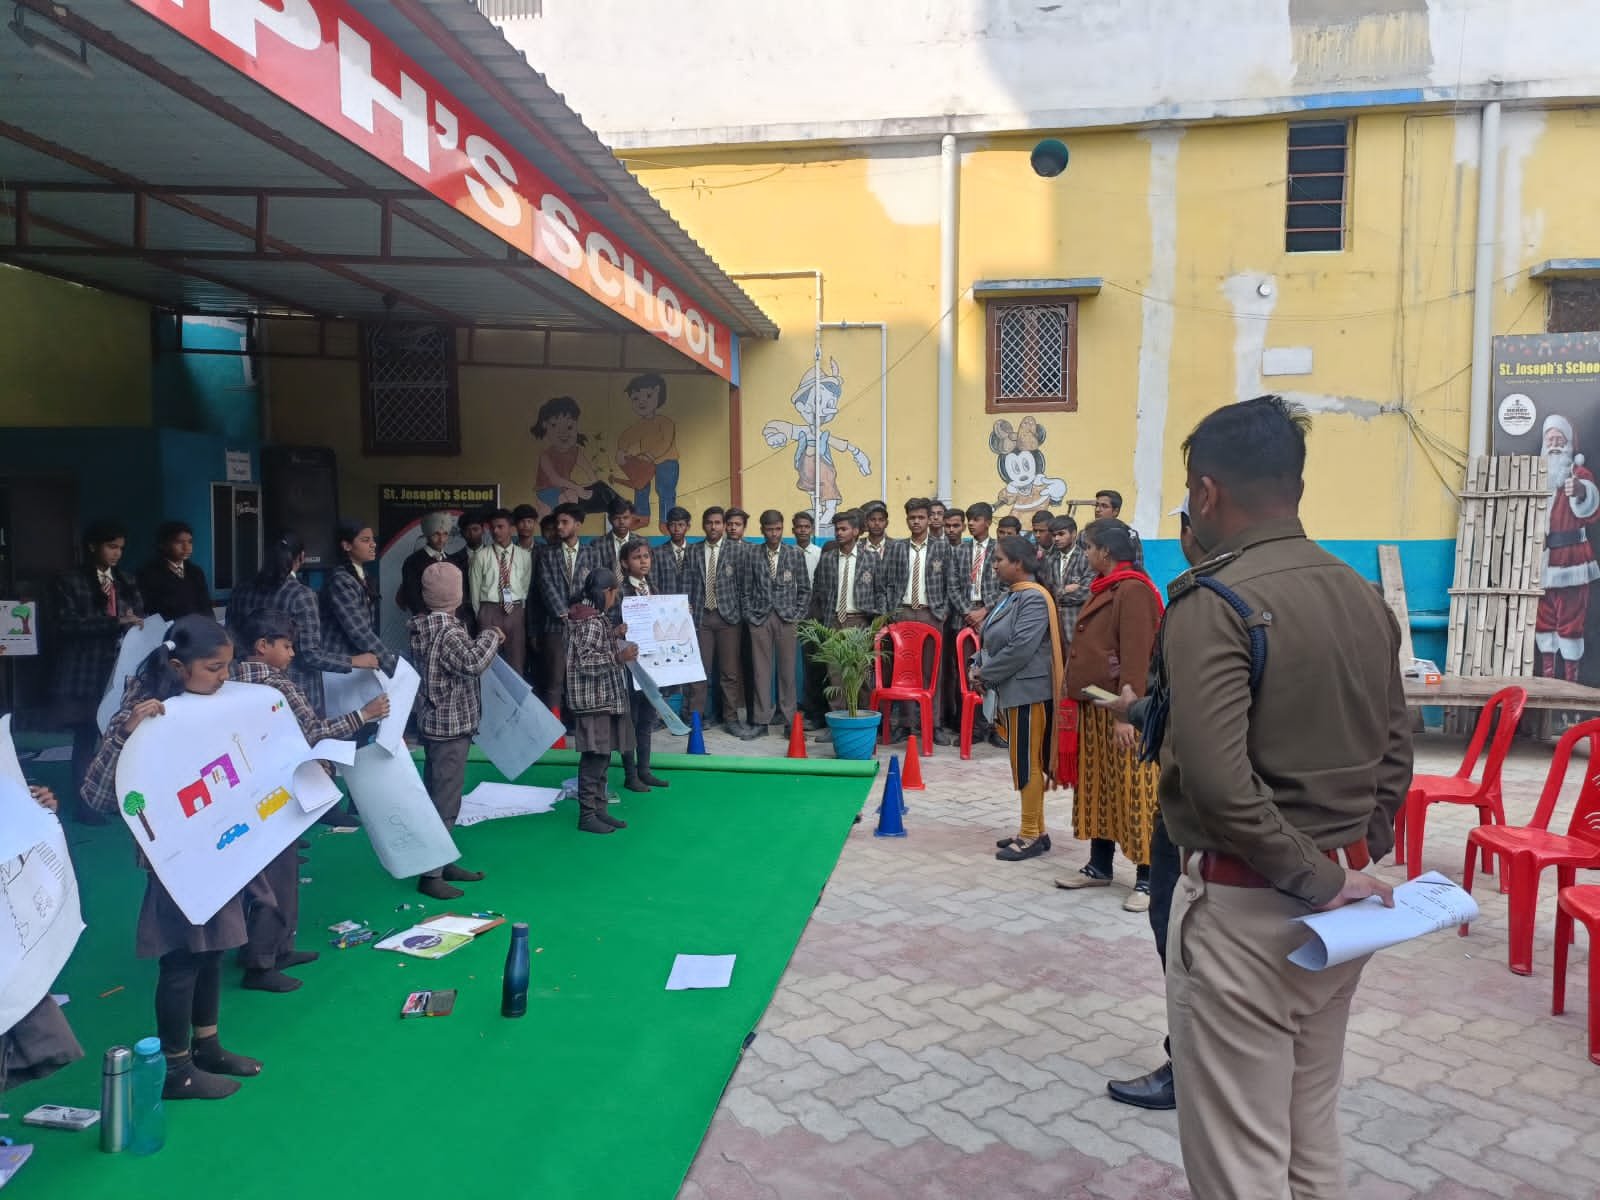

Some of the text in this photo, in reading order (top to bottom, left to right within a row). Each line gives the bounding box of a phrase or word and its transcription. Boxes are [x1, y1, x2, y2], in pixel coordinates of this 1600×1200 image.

[540, 193, 724, 369] SCHOOL
[1499, 363, 1514, 376] St.
[1516, 361, 1563, 376] Joseph's
[401, 488, 451, 502] Joseph's
[453, 489, 494, 501] School
